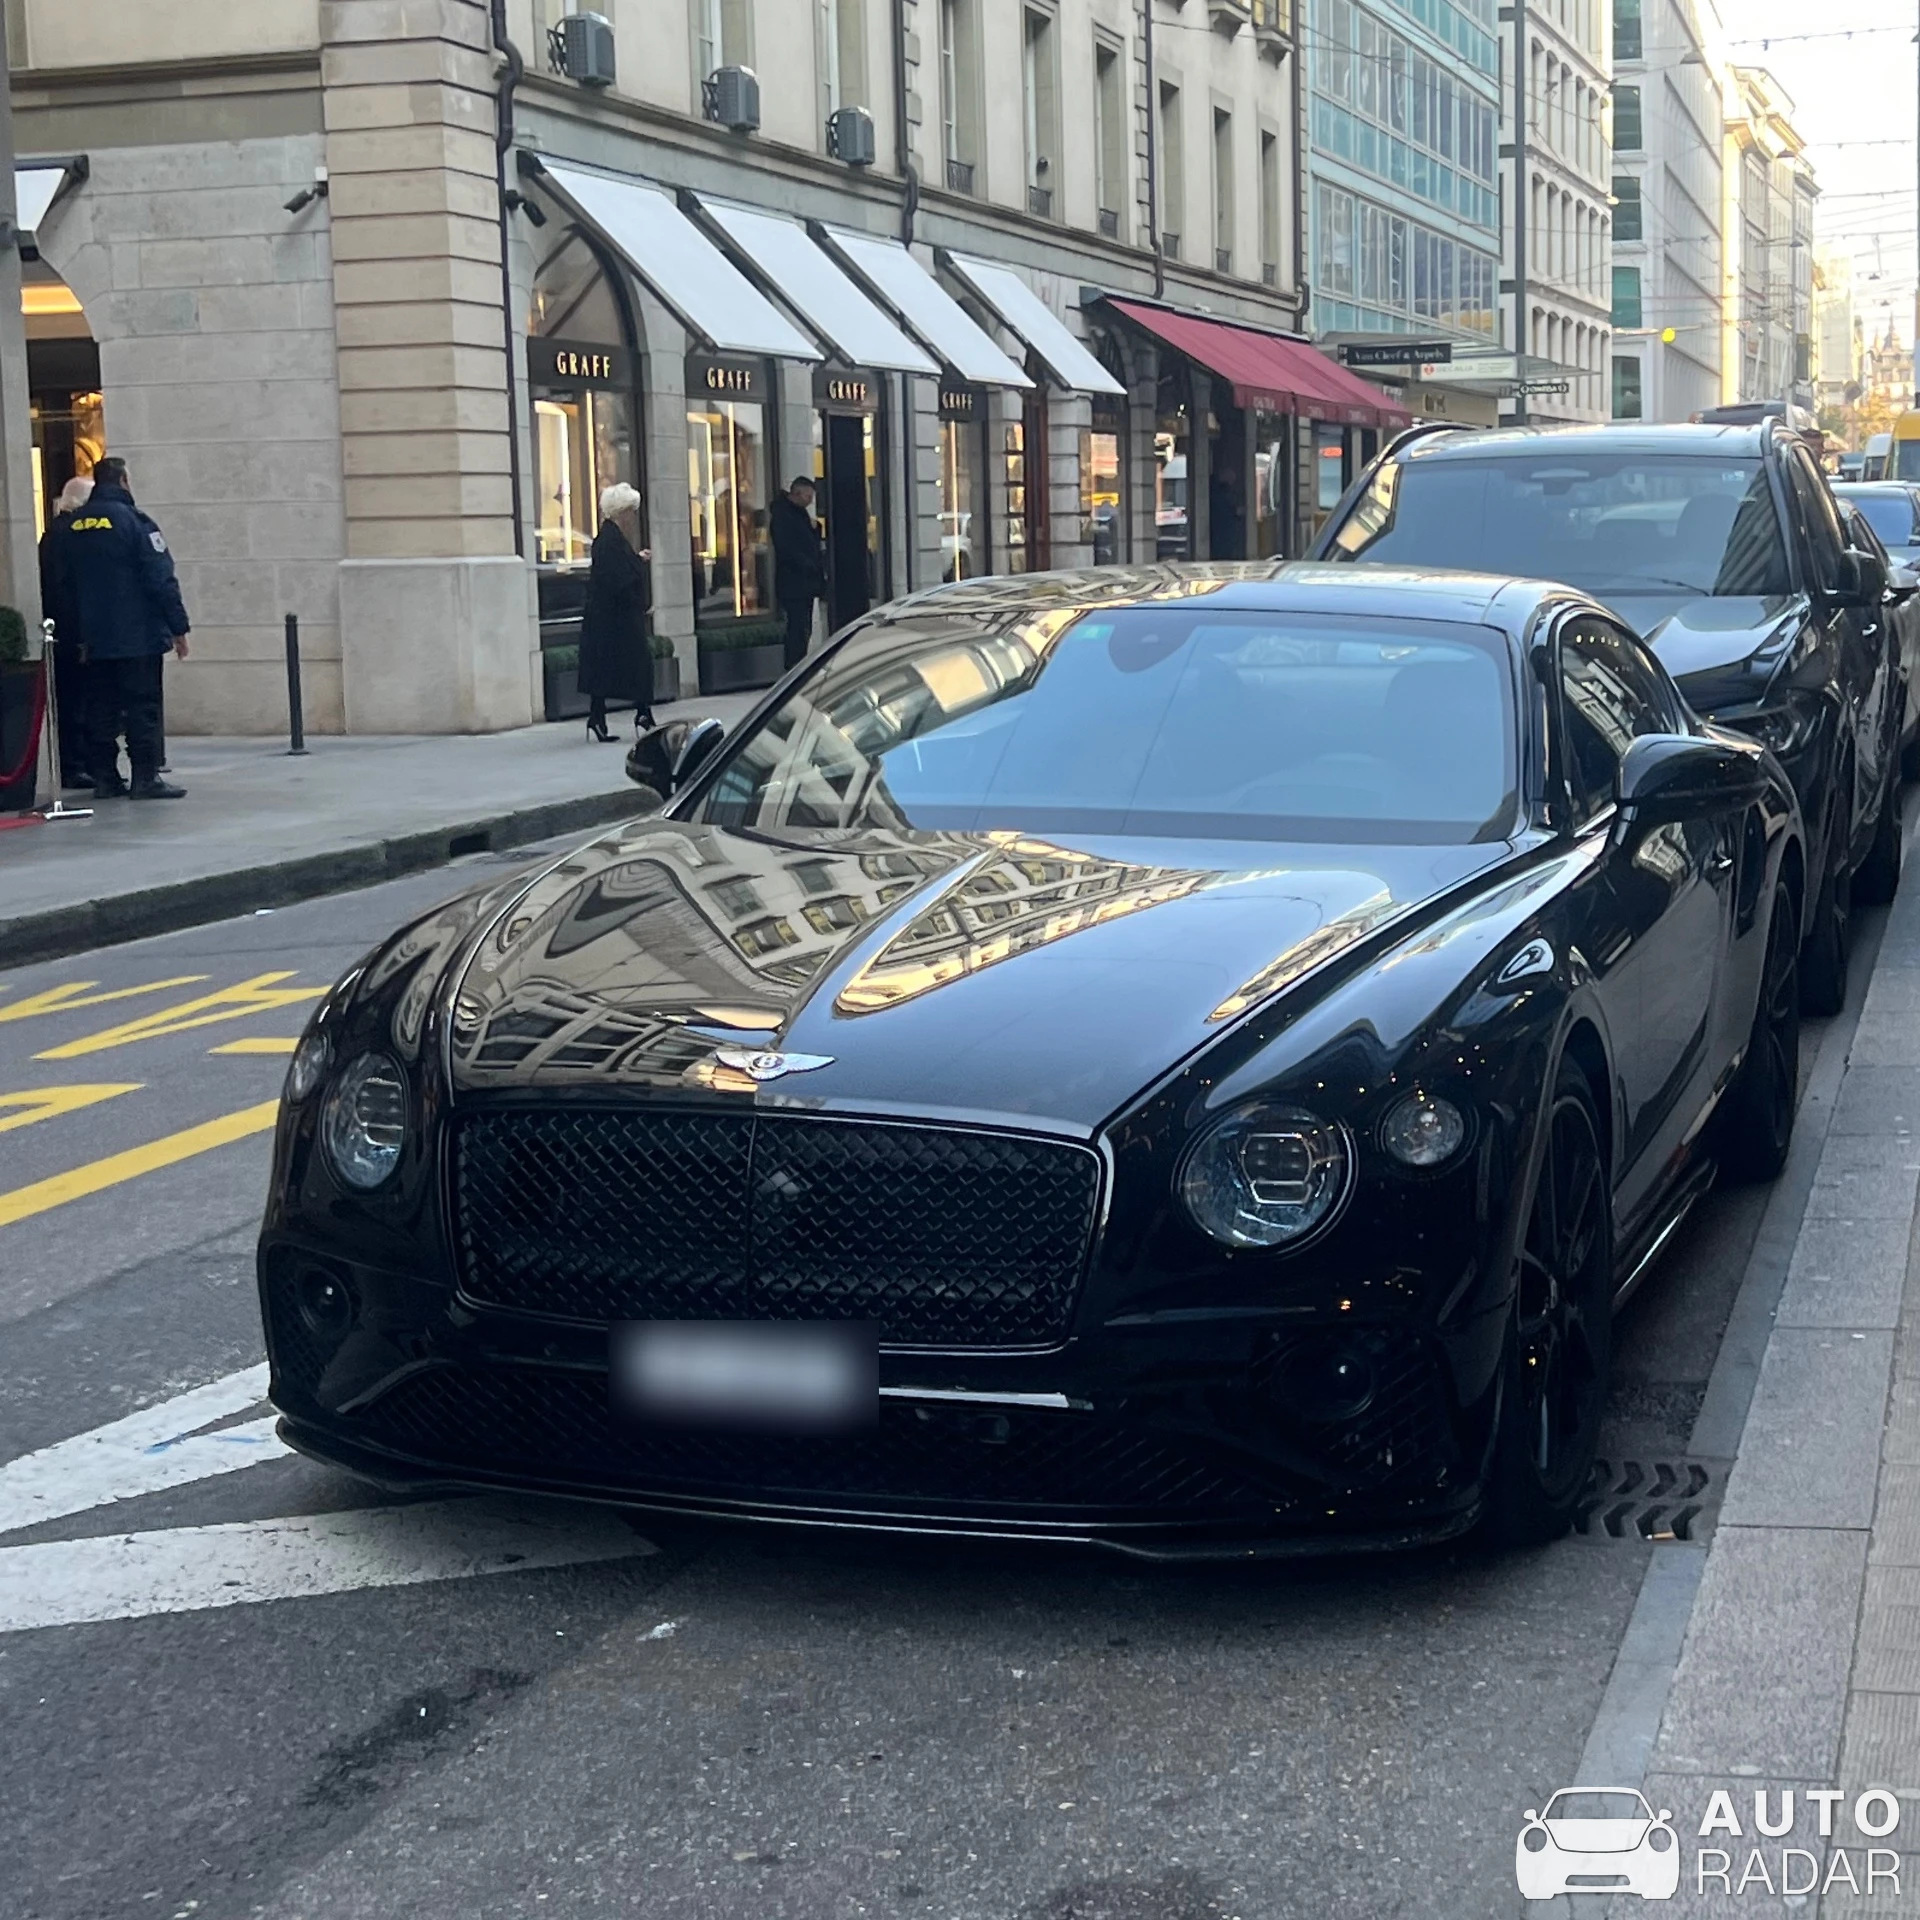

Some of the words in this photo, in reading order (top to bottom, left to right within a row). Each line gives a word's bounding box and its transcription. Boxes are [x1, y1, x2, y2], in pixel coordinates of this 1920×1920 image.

[556, 351, 611, 378] GRAFF
[707, 367, 751, 391] GRAFF
[829, 380, 866, 401] GRAFF
[942, 391, 973, 411] GRAFF
